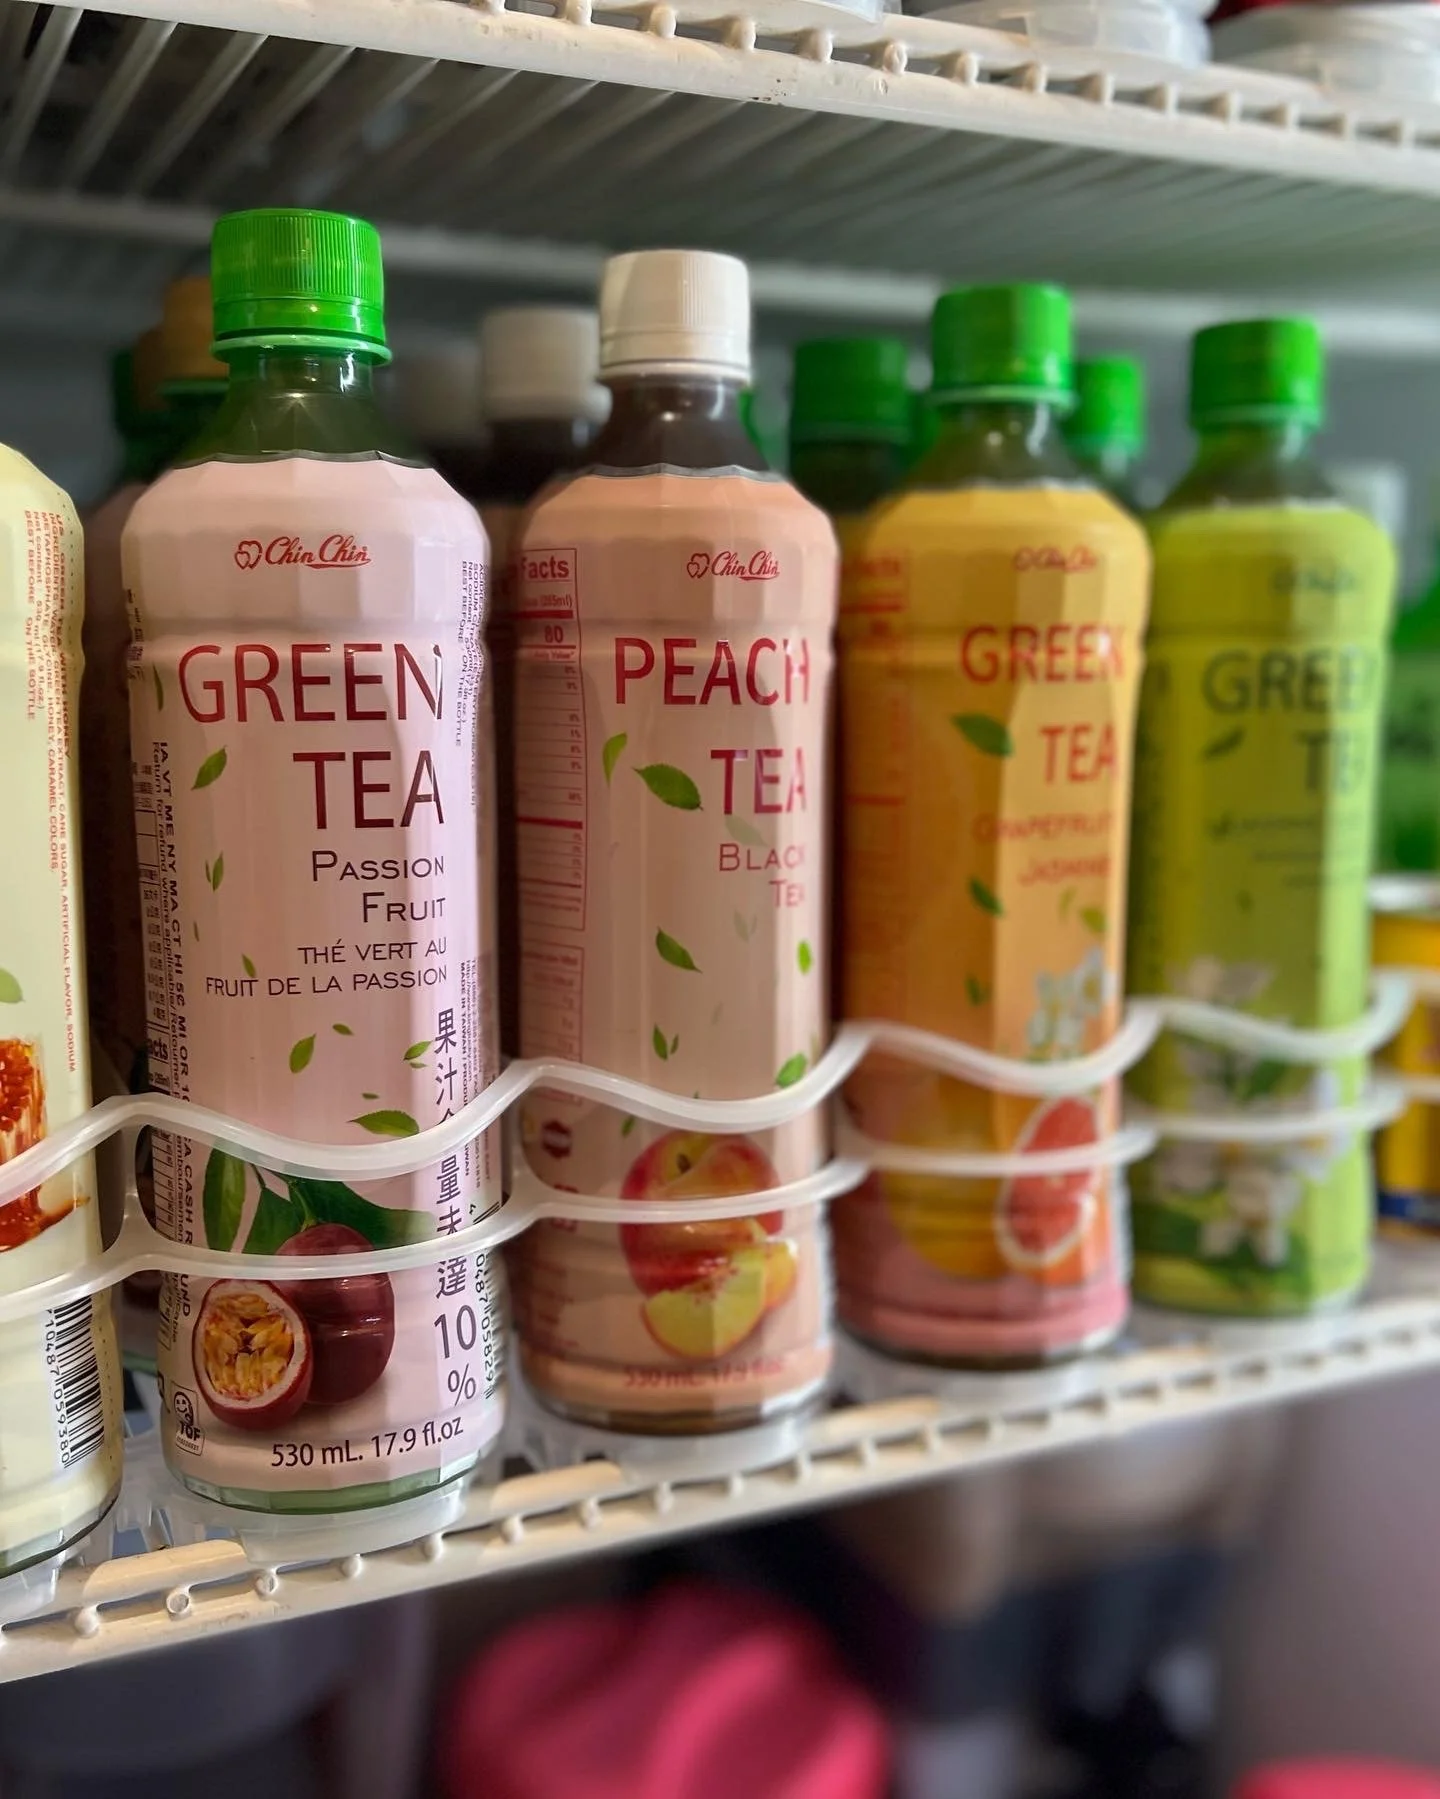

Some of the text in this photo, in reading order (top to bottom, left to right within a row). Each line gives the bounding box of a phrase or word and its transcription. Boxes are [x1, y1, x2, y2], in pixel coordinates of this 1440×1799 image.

[24, 509, 35, 546] BEST
[265, 534, 371, 569] Chin Chin
[711, 550, 780, 580] Chin Chin
[457, 595, 468, 644] BEFORE
[544, 625, 564, 644] 80
[26, 640, 36, 665] THE
[461, 655, 468, 673] ON
[961, 623, 1126, 685] GREEN
[178, 643, 443, 723] GREEN
[457, 676, 465, 698] THE
[615, 637, 809, 706] PEACH
[27, 669, 36, 721] BOTTLE
[153, 742, 162, 794] Return
[1039, 722, 1117, 785] TEA
[48, 748, 56, 813] CARAMEL
[162, 769, 172, 797] VT
[292, 750, 445, 829] TEA
[710, 747, 807, 815] TEA
[156, 799, 164, 818] for
[165, 804, 175, 838] ME
[158, 824, 168, 872] refund
[167, 843, 177, 873] NY
[161, 877, 171, 923] where
[169, 880, 179, 912] MA
[172, 919, 182, 947] CT
[174, 954, 183, 975] HI
[298, 937, 447, 965] THÉ VERT AU
[61, 895, 71, 964] ARTIFICIAL
[67, 1023, 77, 1073] SODIUM
[206, 965, 447, 997] FRUIT DE LA PASSION
[461, 996, 467, 1010] IN
[178, 1015, 187, 1038] MI
[179, 1045, 189, 1076] OR
[183, 1165, 194, 1224] CASH
[271, 1416, 464, 1467] 530 mL. 17.9 fl.oz
